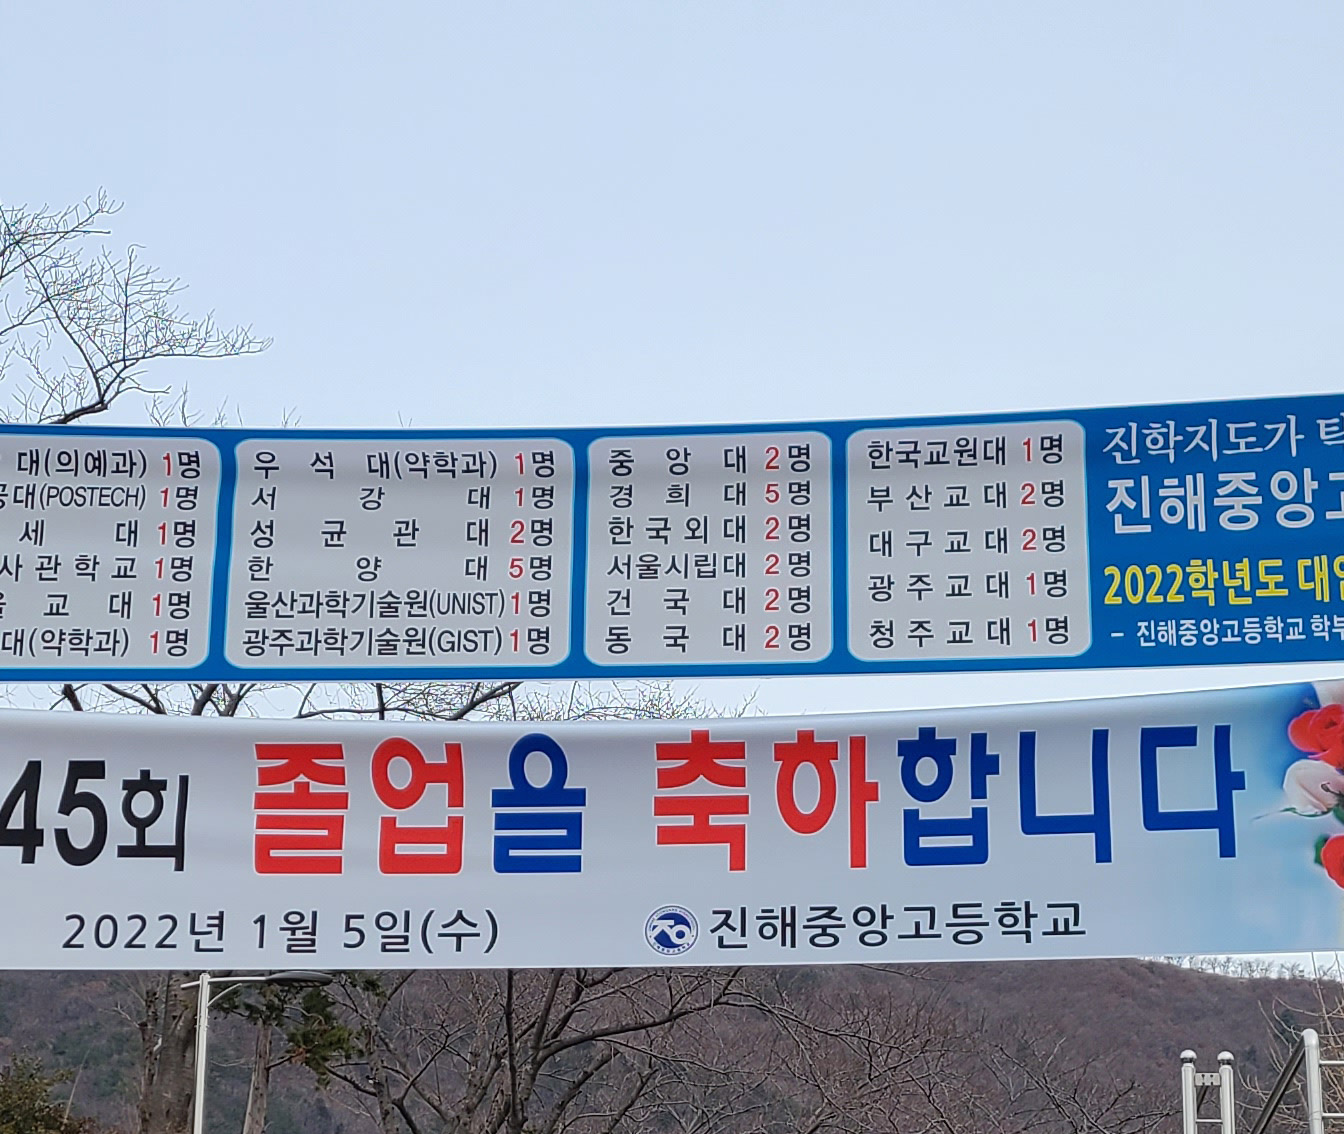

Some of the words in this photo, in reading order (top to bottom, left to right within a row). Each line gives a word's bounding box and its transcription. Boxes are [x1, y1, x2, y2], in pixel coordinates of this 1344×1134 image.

[868, 437, 1005, 469] 한국교원대
[1104, 415, 1304, 464] 진학지도가
[607, 553, 745, 580] 서울시립대
[1105, 558, 1288, 606] 2022학년도
[245, 589, 504, 618] 울산과학기술원(UNIST)
[243, 626, 502, 656] 광주과학기술원(GIST)
[1138, 616, 1305, 646] 진해중앙고등학교
[254, 733, 586, 874] 졸업을
[654, 724, 1246, 872] 축하합니다
[63, 911, 224, 952] 2022년
[254, 911, 317, 953] 1월
[344, 910, 497, 953] 5일(수)
[710, 901, 1086, 948] 진해중앙고등학교
